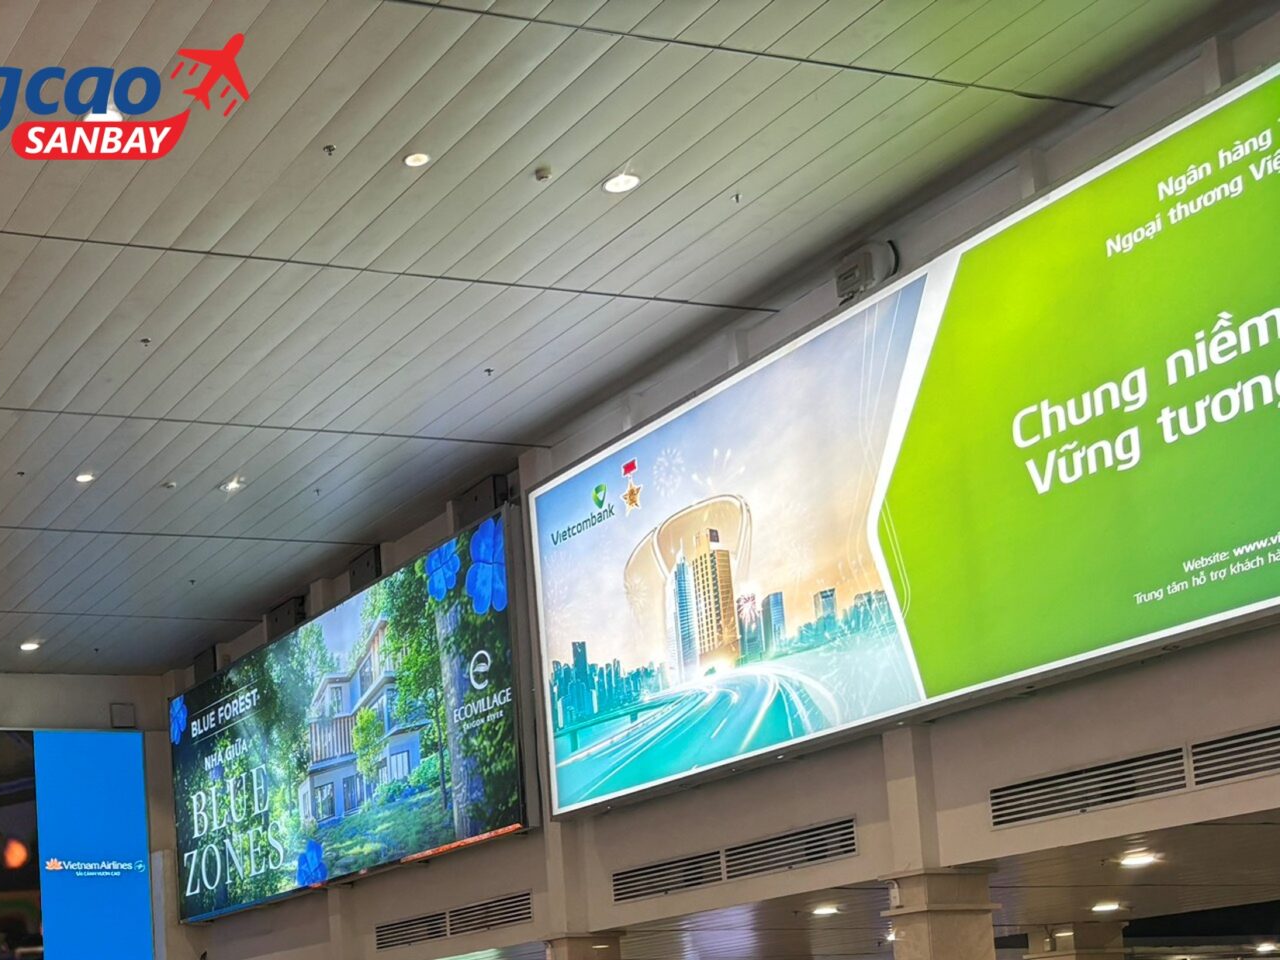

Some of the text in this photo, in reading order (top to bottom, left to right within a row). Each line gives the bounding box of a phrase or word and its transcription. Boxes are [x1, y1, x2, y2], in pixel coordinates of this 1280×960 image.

[1157, 128, 1272, 201] Ngân hàng
[1105, 213, 1163, 258] Ngoại
[1167, 175, 1243, 225] thương
[1012, 311, 1280, 449] Chung niềm
[1025, 426, 1141, 495] Vững
[550, 503, 615, 546] Vietcombank
[1133, 555, 1264, 605] Trung tâm hỗ trợ khách
[1182, 551, 1230, 573] Website:
[191, 687, 260, 738] BLUE FOREST
[453, 687, 513, 723] ECOVILLAGE
[225, 738, 248, 761] GIỮA
[190, 763, 270, 839] BLUE
[62, 860, 133, 870] Vietnam Airlines
[183, 821, 285, 897] ZONES
